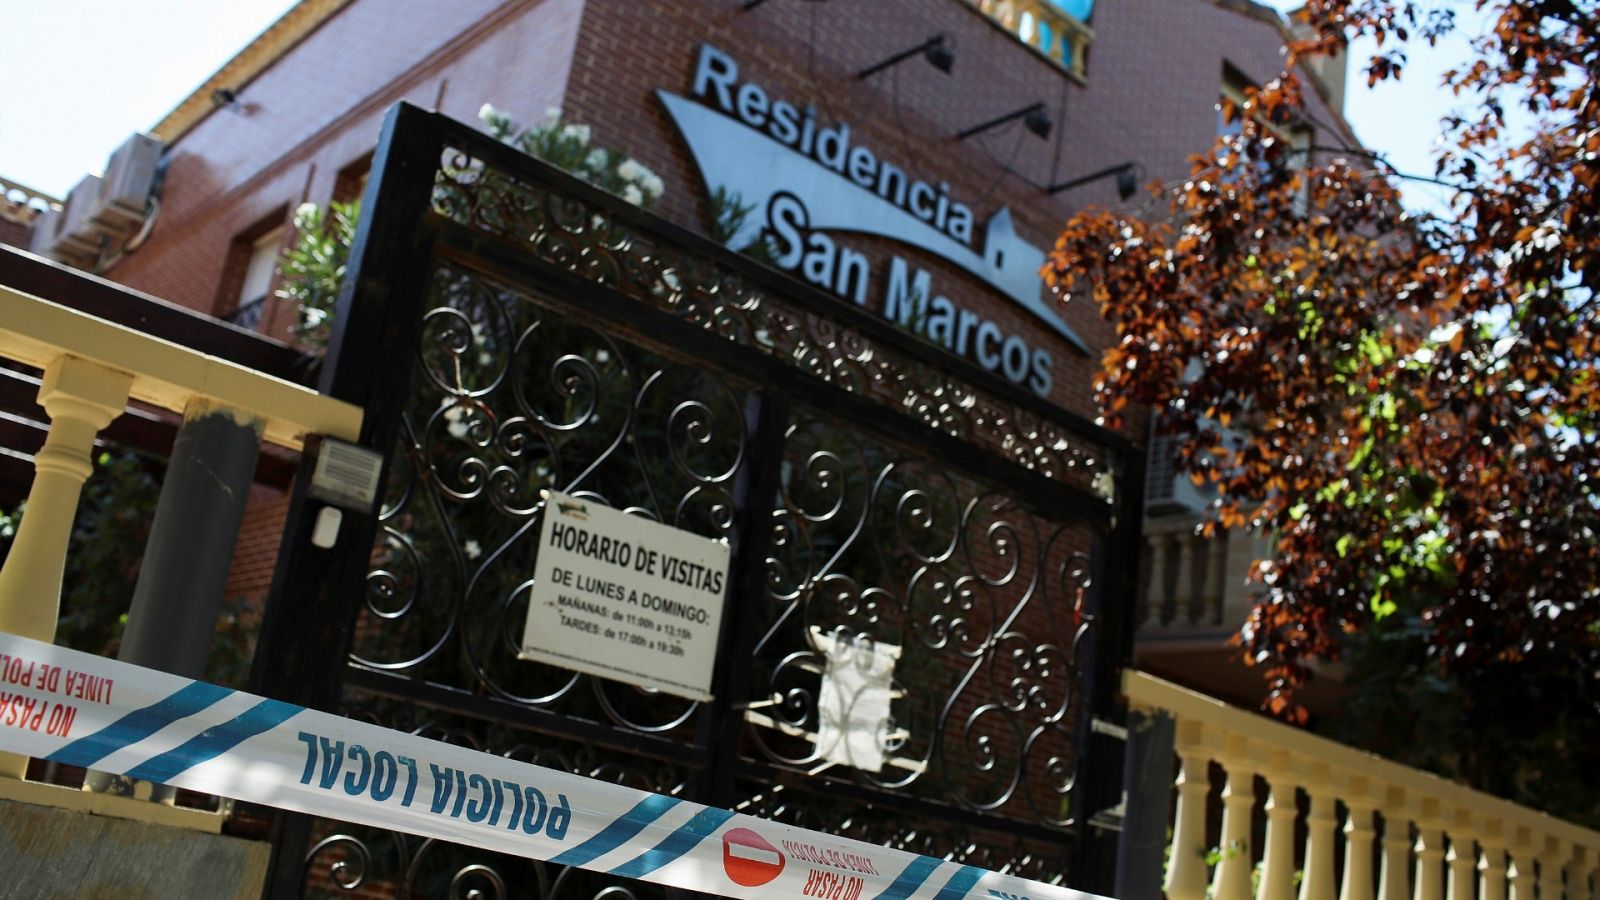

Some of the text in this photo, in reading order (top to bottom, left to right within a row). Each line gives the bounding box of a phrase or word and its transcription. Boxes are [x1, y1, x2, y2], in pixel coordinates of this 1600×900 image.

[692, 43, 975, 246] Residencia
[766, 192, 1054, 398] San Marcos
[550, 522, 723, 595] HORARIO DE VISITAS
[551, 567, 711, 626] DE LUNES A DOMINGO:
[612, 611, 623, 622] de
[656, 624, 662, 632] a
[604, 628, 615, 639] de
[0, 653, 113, 705] LINEA DE POL
[46, 703, 77, 738] NO
[298, 731, 572, 841] POLICIA LOCAL
[782, 840, 880, 876] LINEA DE POLICIA
[803, 869, 864, 900] NO PASAR
